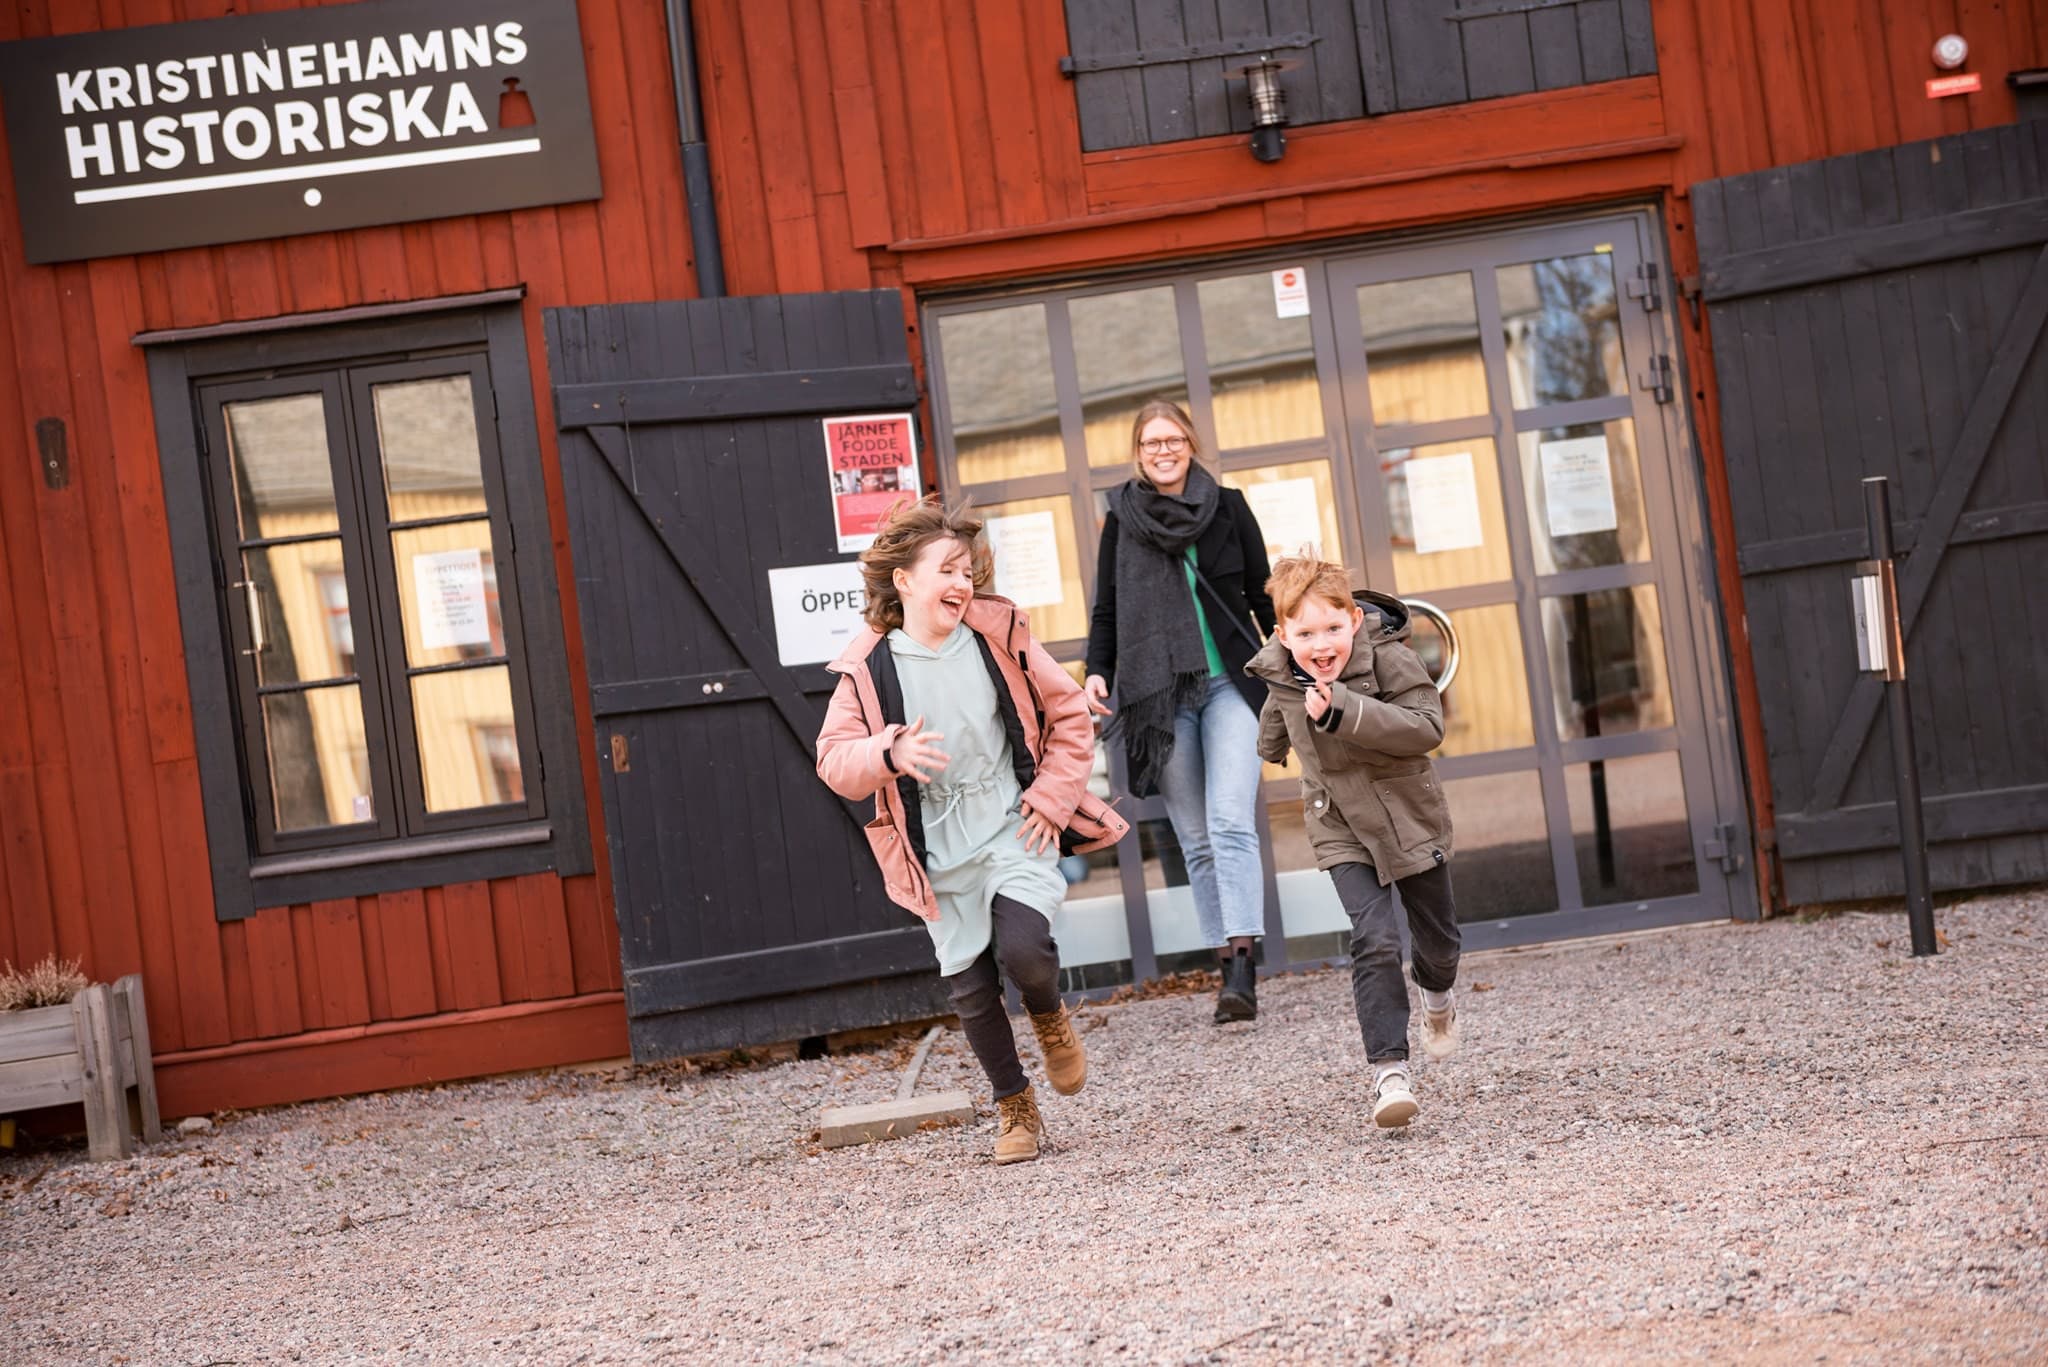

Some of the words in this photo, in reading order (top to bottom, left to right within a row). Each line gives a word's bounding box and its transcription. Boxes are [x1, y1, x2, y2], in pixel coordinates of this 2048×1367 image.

[56, 21, 528, 114] KRISTINEHAMNS
[65, 82, 489, 179] HISTORISKA
[839, 452, 904, 468] STADEN
